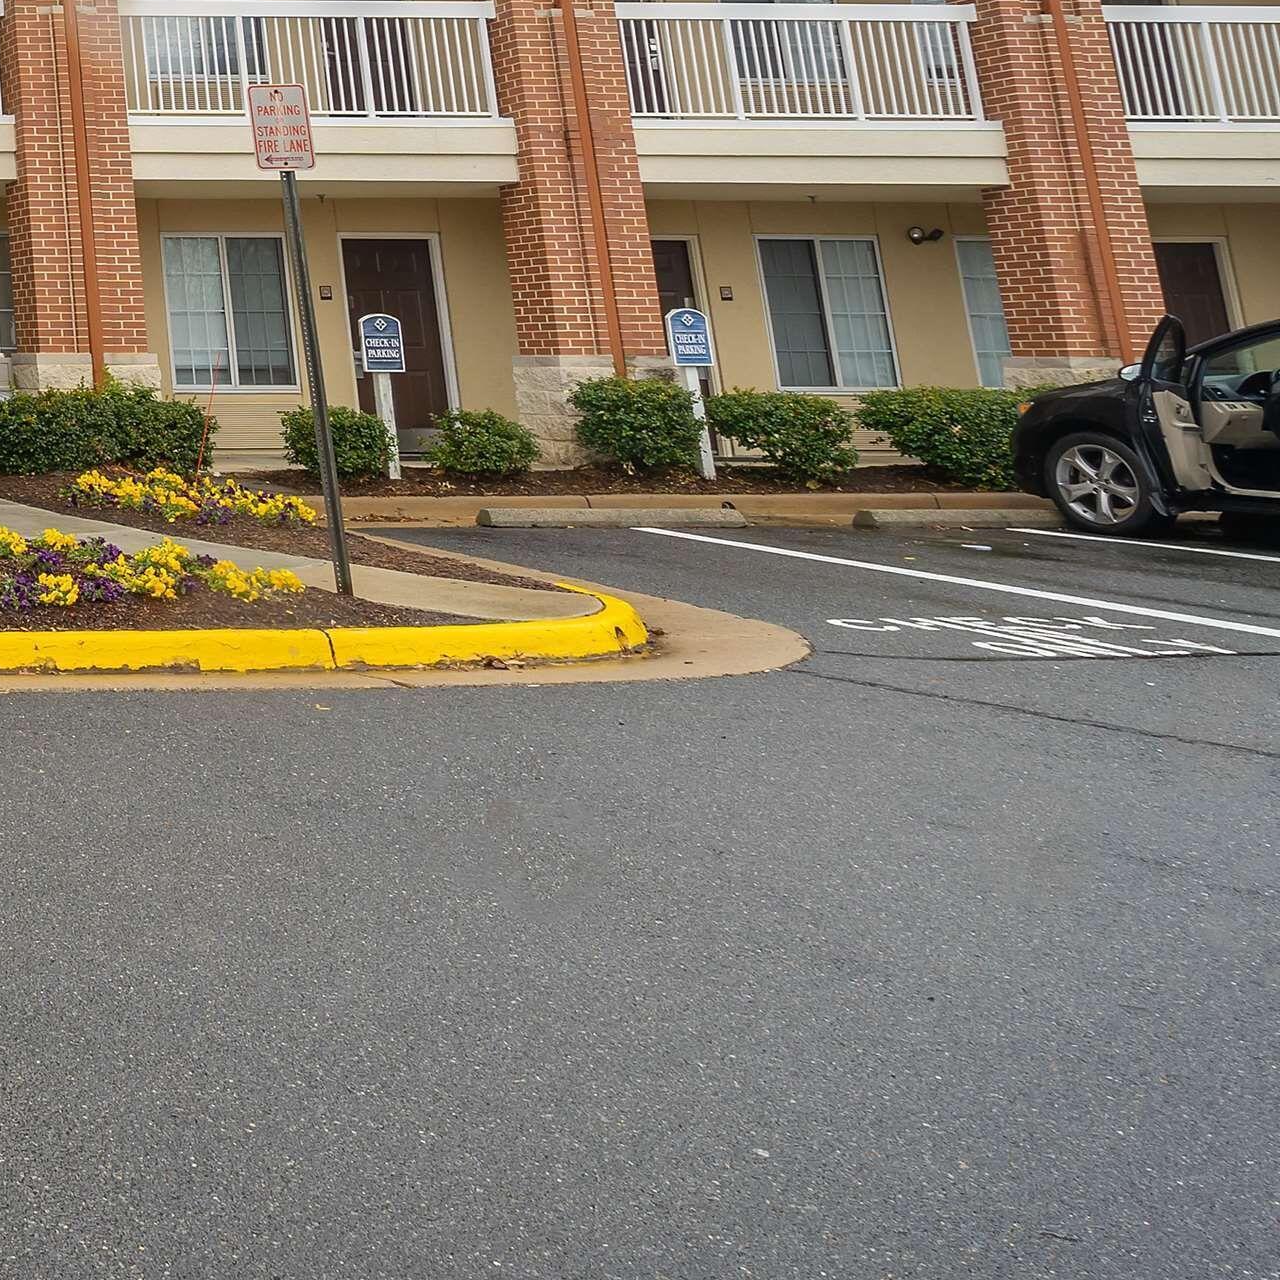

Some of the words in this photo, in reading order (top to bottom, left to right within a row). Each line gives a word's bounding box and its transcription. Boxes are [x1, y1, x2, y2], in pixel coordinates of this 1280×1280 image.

[269, 91, 284, 102] NO
[257, 104, 301, 116] PARKING
[256, 125, 307, 137] STANDING
[257, 140, 280, 153] FIRE
[283, 139, 310, 152] LANE
[365, 338, 400, 347] CHECK-IN
[367, 349, 400, 358] PARKING
[677, 345, 707, 354] PARKING
